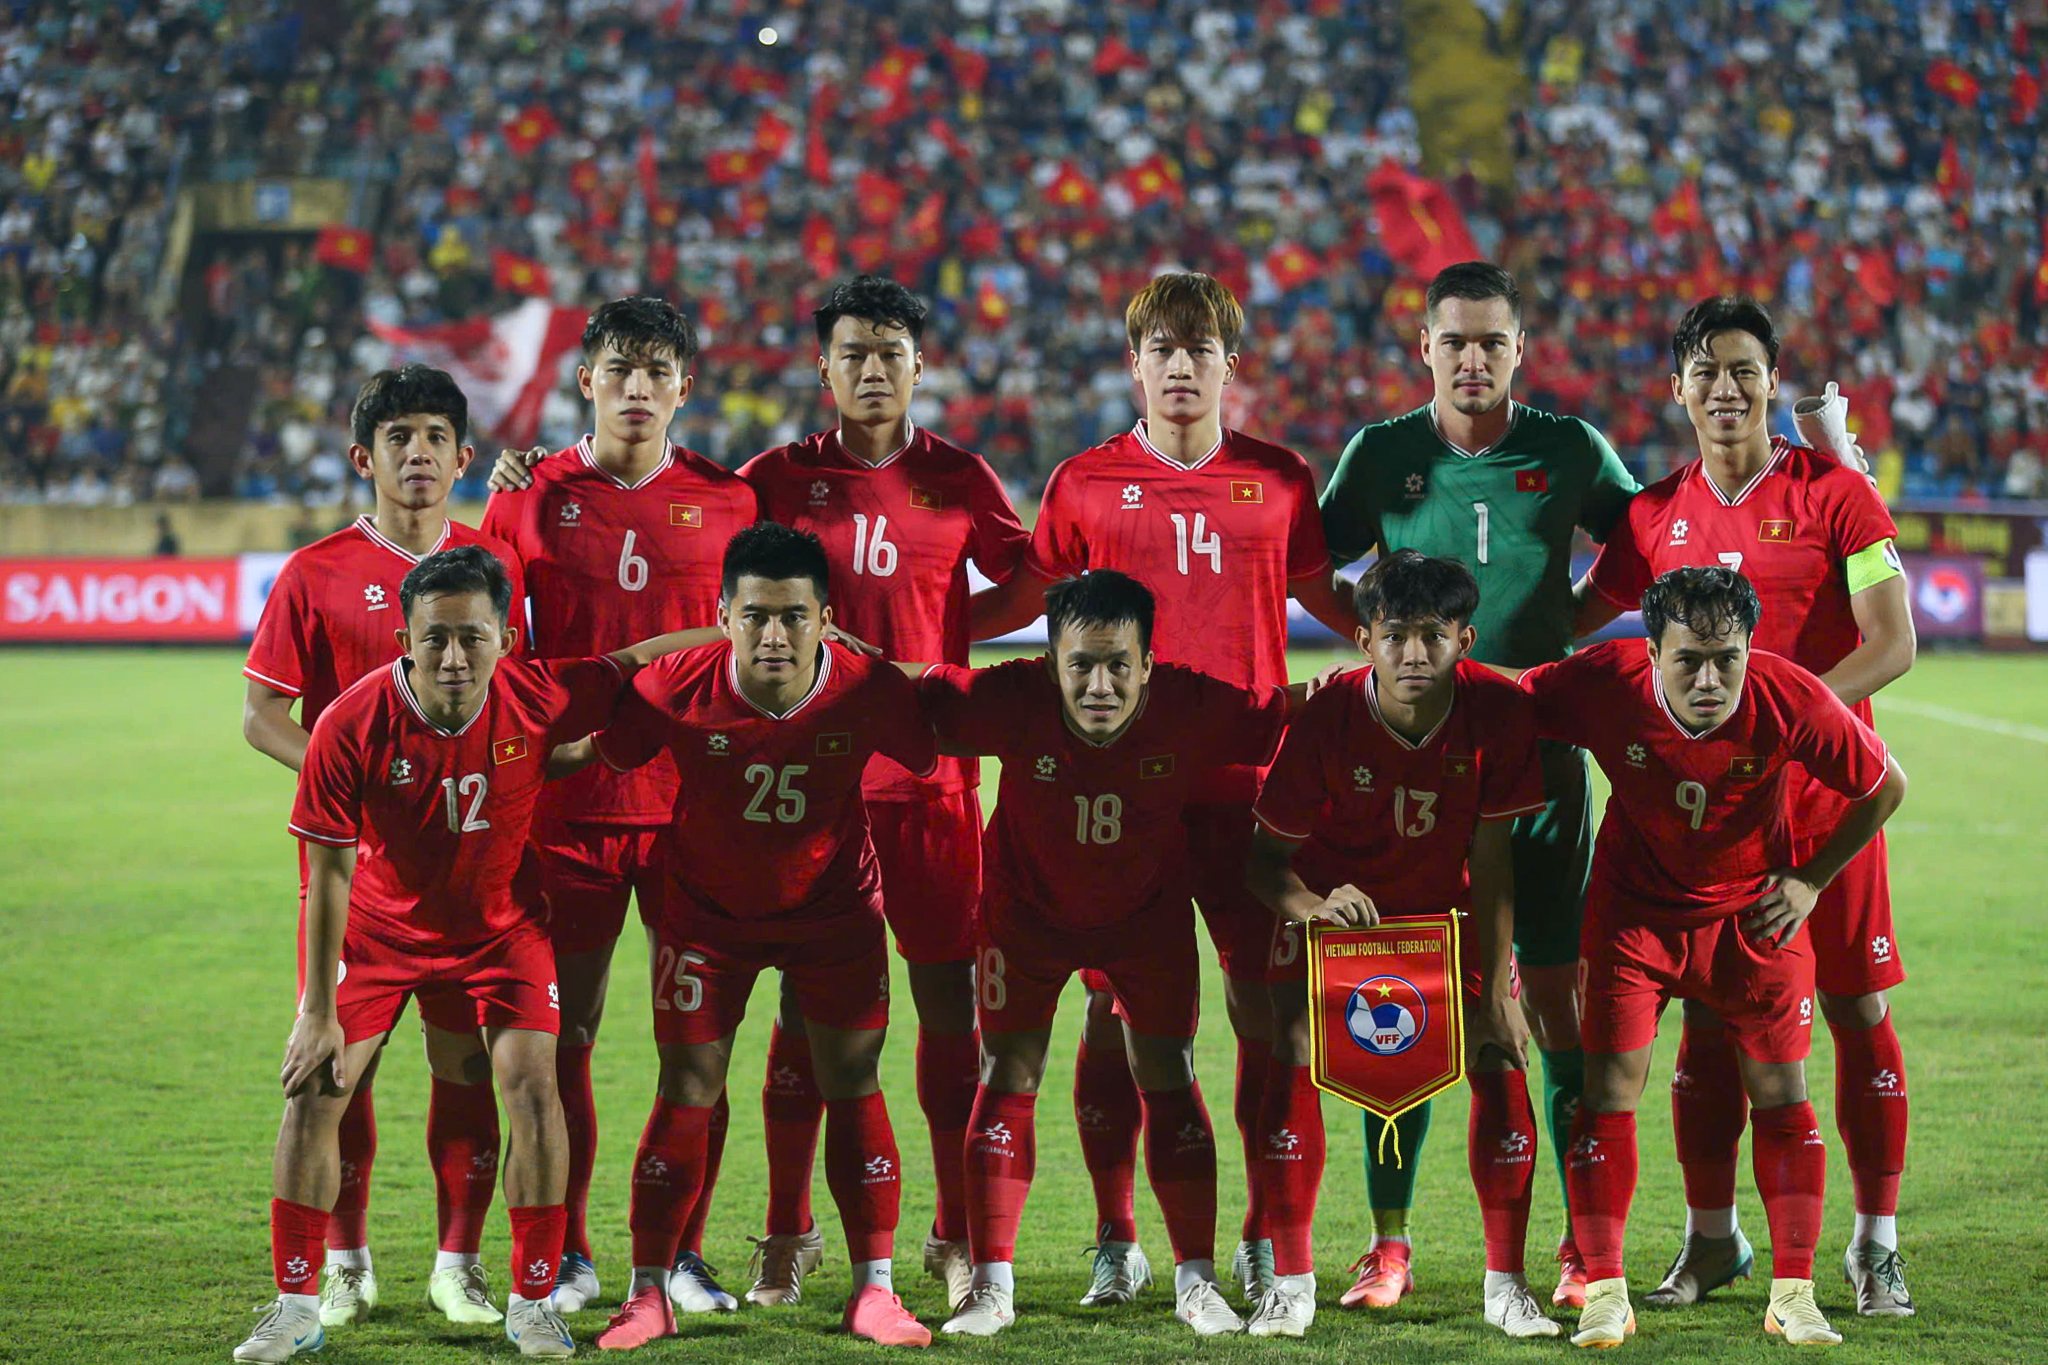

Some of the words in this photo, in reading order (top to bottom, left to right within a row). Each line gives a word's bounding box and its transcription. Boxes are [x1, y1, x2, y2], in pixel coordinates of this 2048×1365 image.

[618, 530, 649, 592] 6
[853, 514, 898, 577] 16
[1170, 513, 1222, 575] 14
[1473, 502, 1489, 564] 1
[5, 573, 227, 623] SAIGON
[441, 773, 491, 834] 12
[743, 764, 809, 822] 25
[1074, 793, 1123, 845] 18
[1394, 785, 1439, 837] 13
[1675, 780, 1707, 830] 9
[655, 944, 707, 1011] 25
[1325, 943, 1357, 958] VIETNAM
[1358, 941, 1395, 956] FOOTBALL
[1397, 939, 1442, 955] FEDERATION
[1375, 1034, 1400, 1045] VFF
